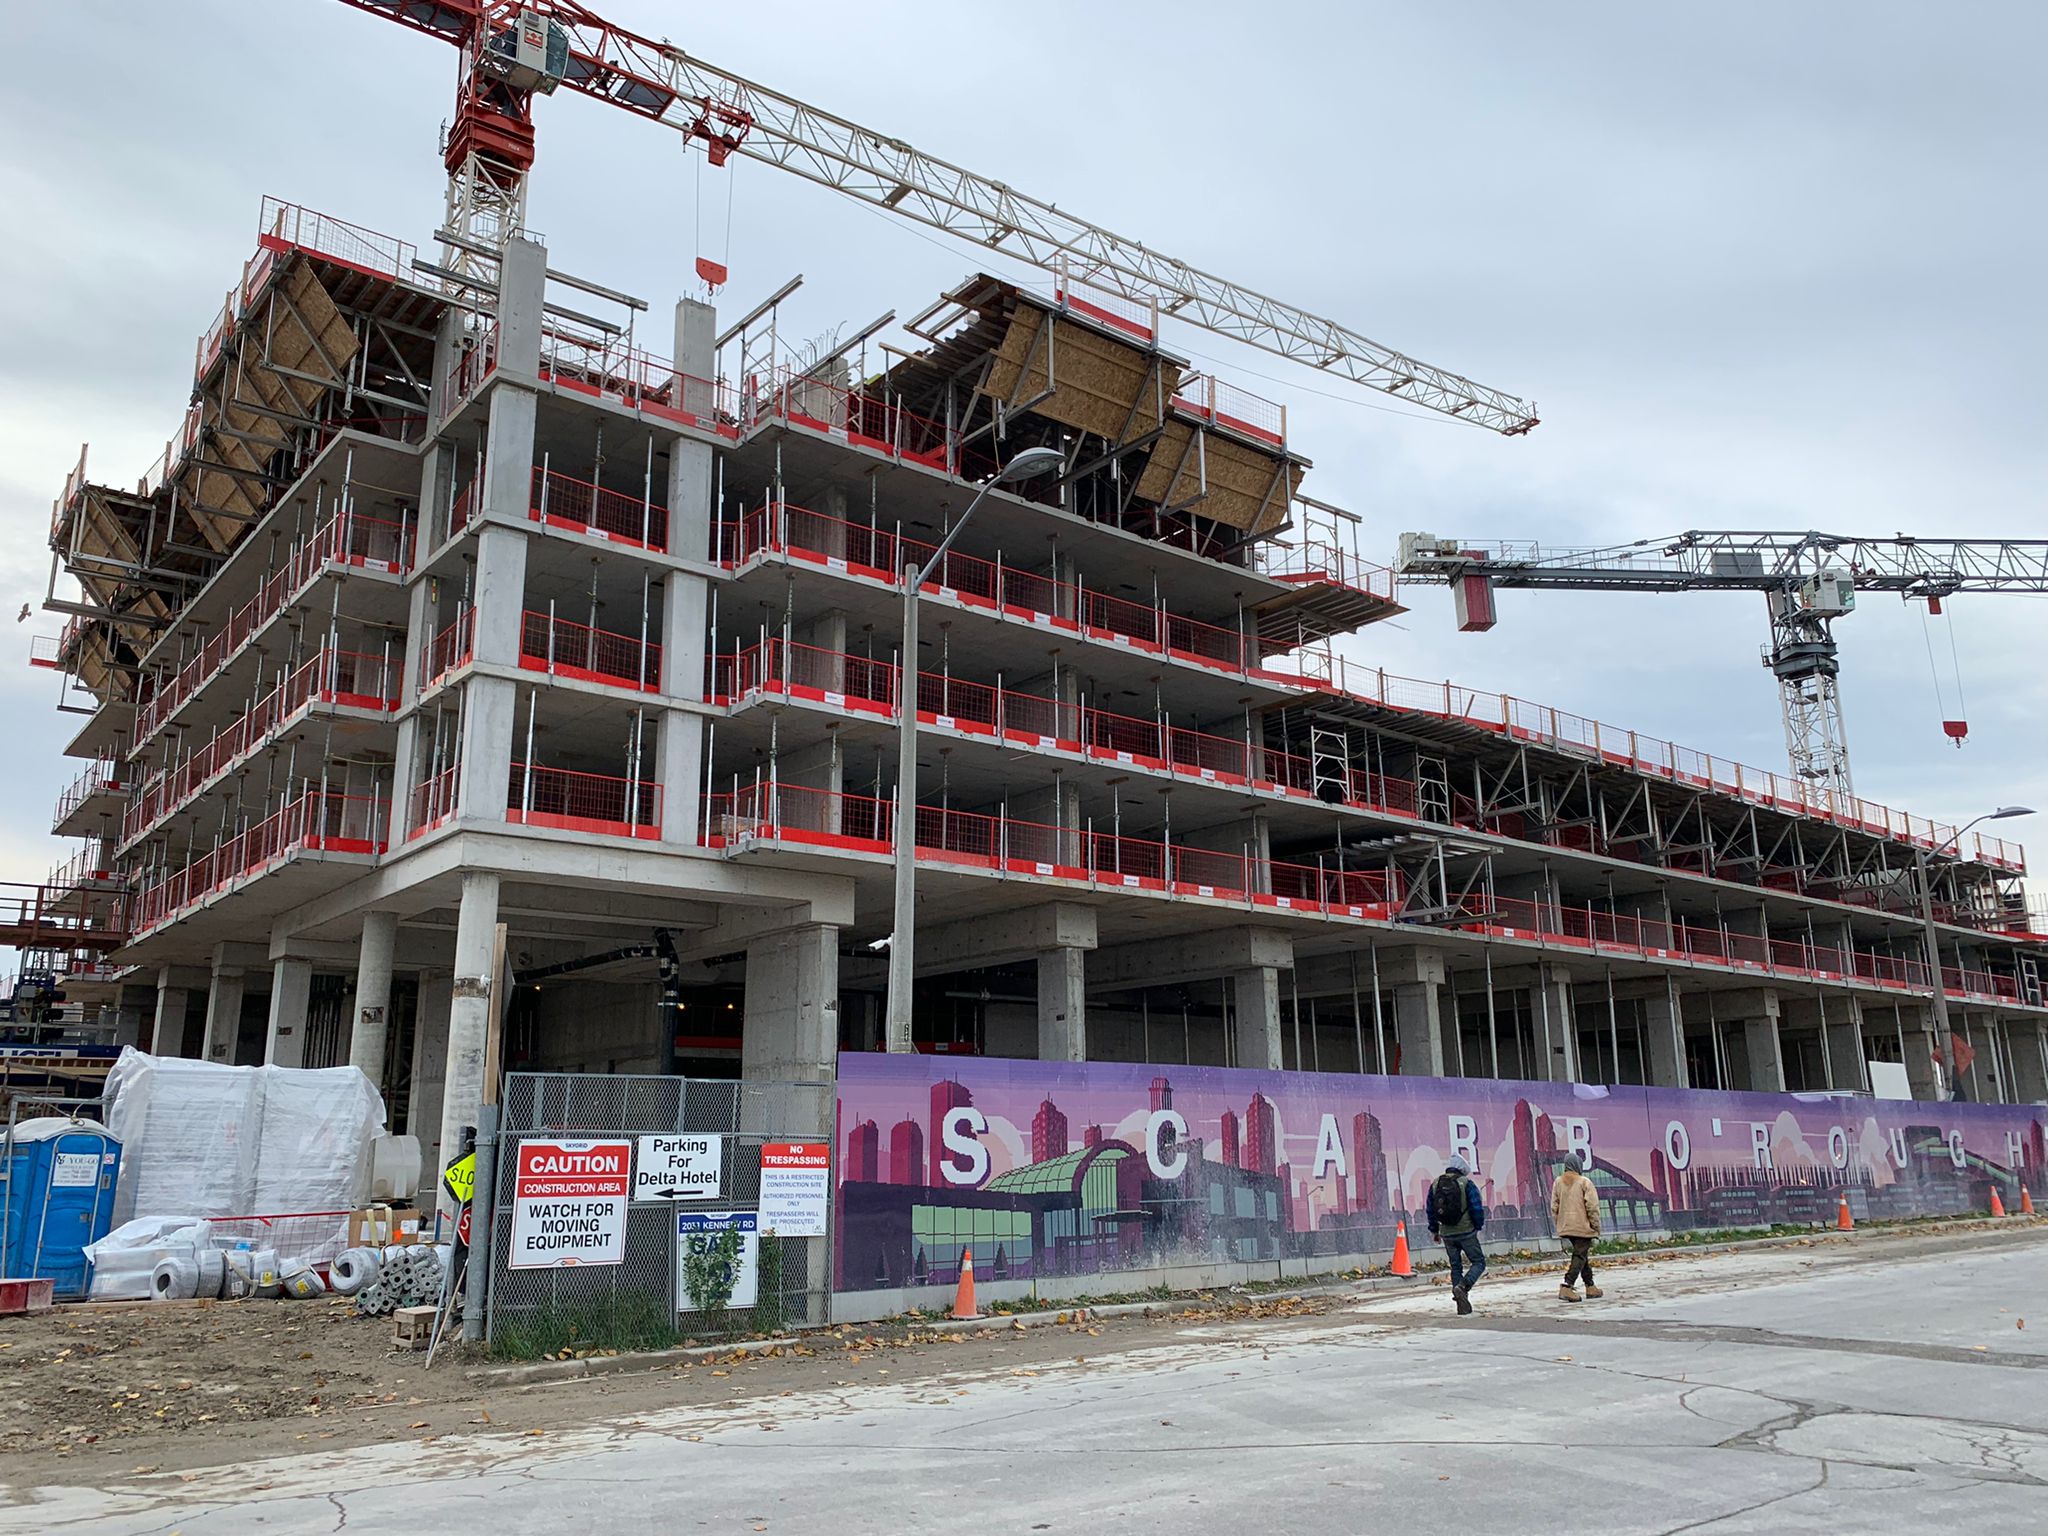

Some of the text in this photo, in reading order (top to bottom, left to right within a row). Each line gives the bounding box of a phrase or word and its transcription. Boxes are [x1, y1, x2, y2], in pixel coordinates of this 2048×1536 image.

[653, 1138, 708, 1154] Parking
[789, 1145, 804, 1154] NO
[529, 1156, 619, 1173] CAUTION
[668, 1155, 692, 1168] For
[764, 1155, 827, 1165] TRESPASSING
[638, 1170, 718, 1185] Delta Hotel
[524, 1182, 621, 1194] CONSTRUCTION AREA
[529, 1203, 614, 1218] WATCH FOR
[541, 1219, 600, 1233] MOVING
[743, 1220, 754, 1229] RD
[526, 1233, 612, 1250] EQUIPMENT
